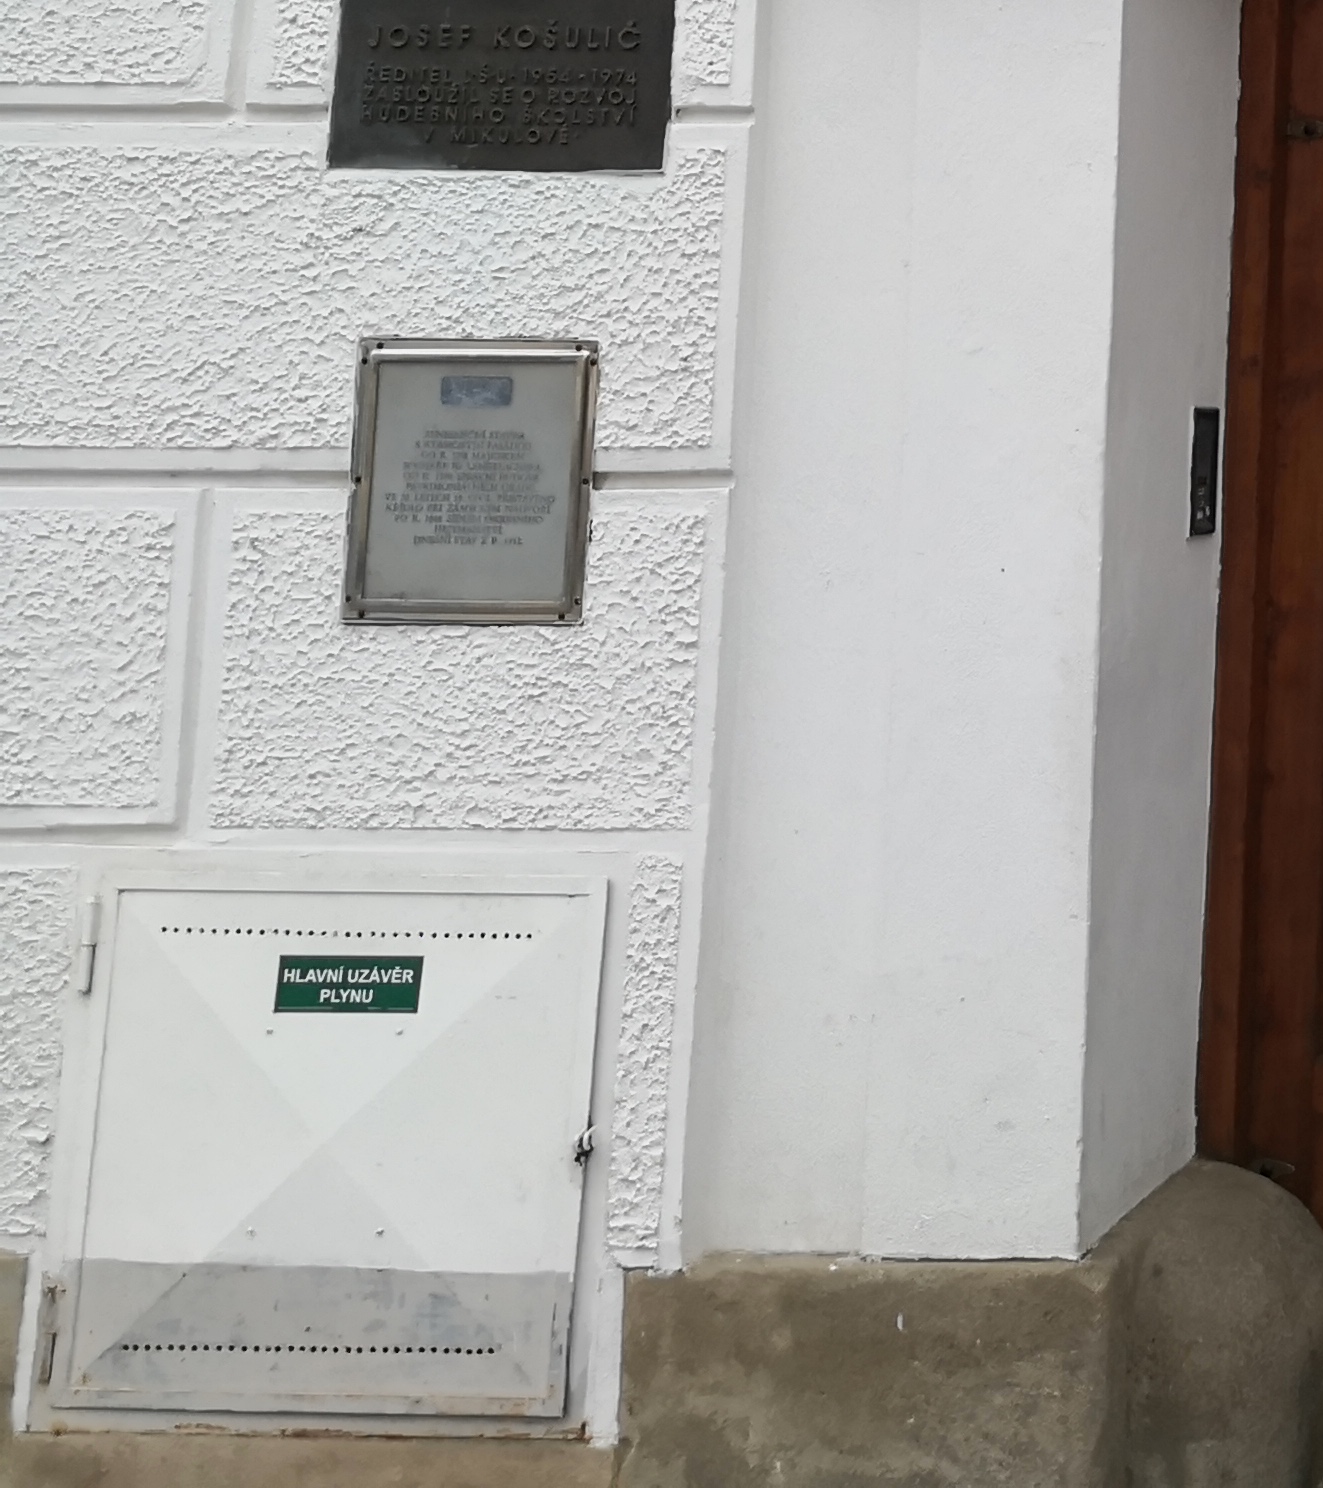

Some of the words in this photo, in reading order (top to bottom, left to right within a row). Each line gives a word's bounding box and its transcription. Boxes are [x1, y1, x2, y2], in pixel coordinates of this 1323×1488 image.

[367, 23, 475, 49] JOSEF
[547, 86, 637, 105] ROZVOJ
[283, 967, 344, 984] HLAVNÍ
[347, 966, 414, 984] UZÁVĚR
[319, 988, 374, 1003] PLYNU
